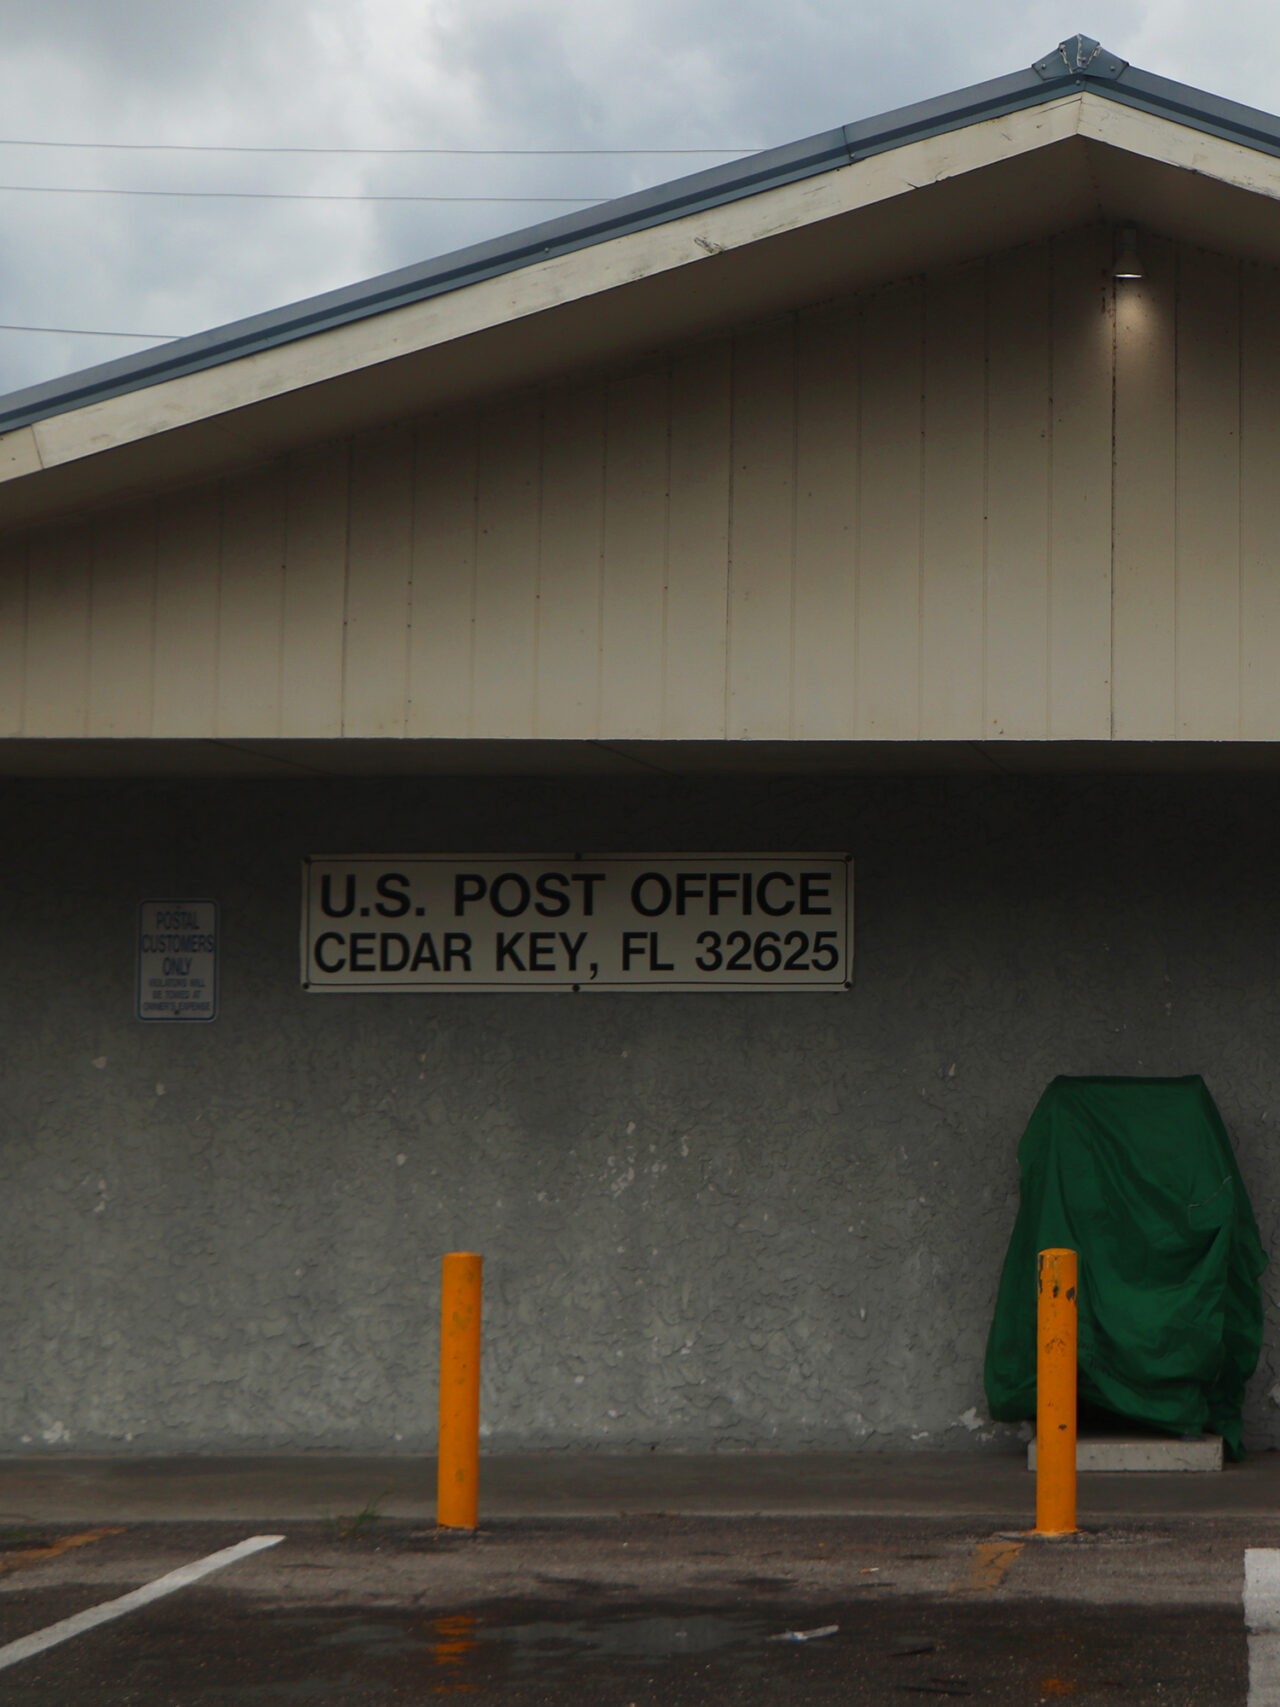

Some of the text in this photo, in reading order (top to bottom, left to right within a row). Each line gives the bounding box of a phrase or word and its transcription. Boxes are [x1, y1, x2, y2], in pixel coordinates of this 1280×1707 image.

[320, 871, 833, 918] U.S. POST OFFICE
[156, 911, 200, 931] POSTAL
[142, 933, 216, 953] CUSTOMERS
[314, 930, 840, 979] CEDAR KEY, FL 32625
[162, 956, 193, 976] ONLY
